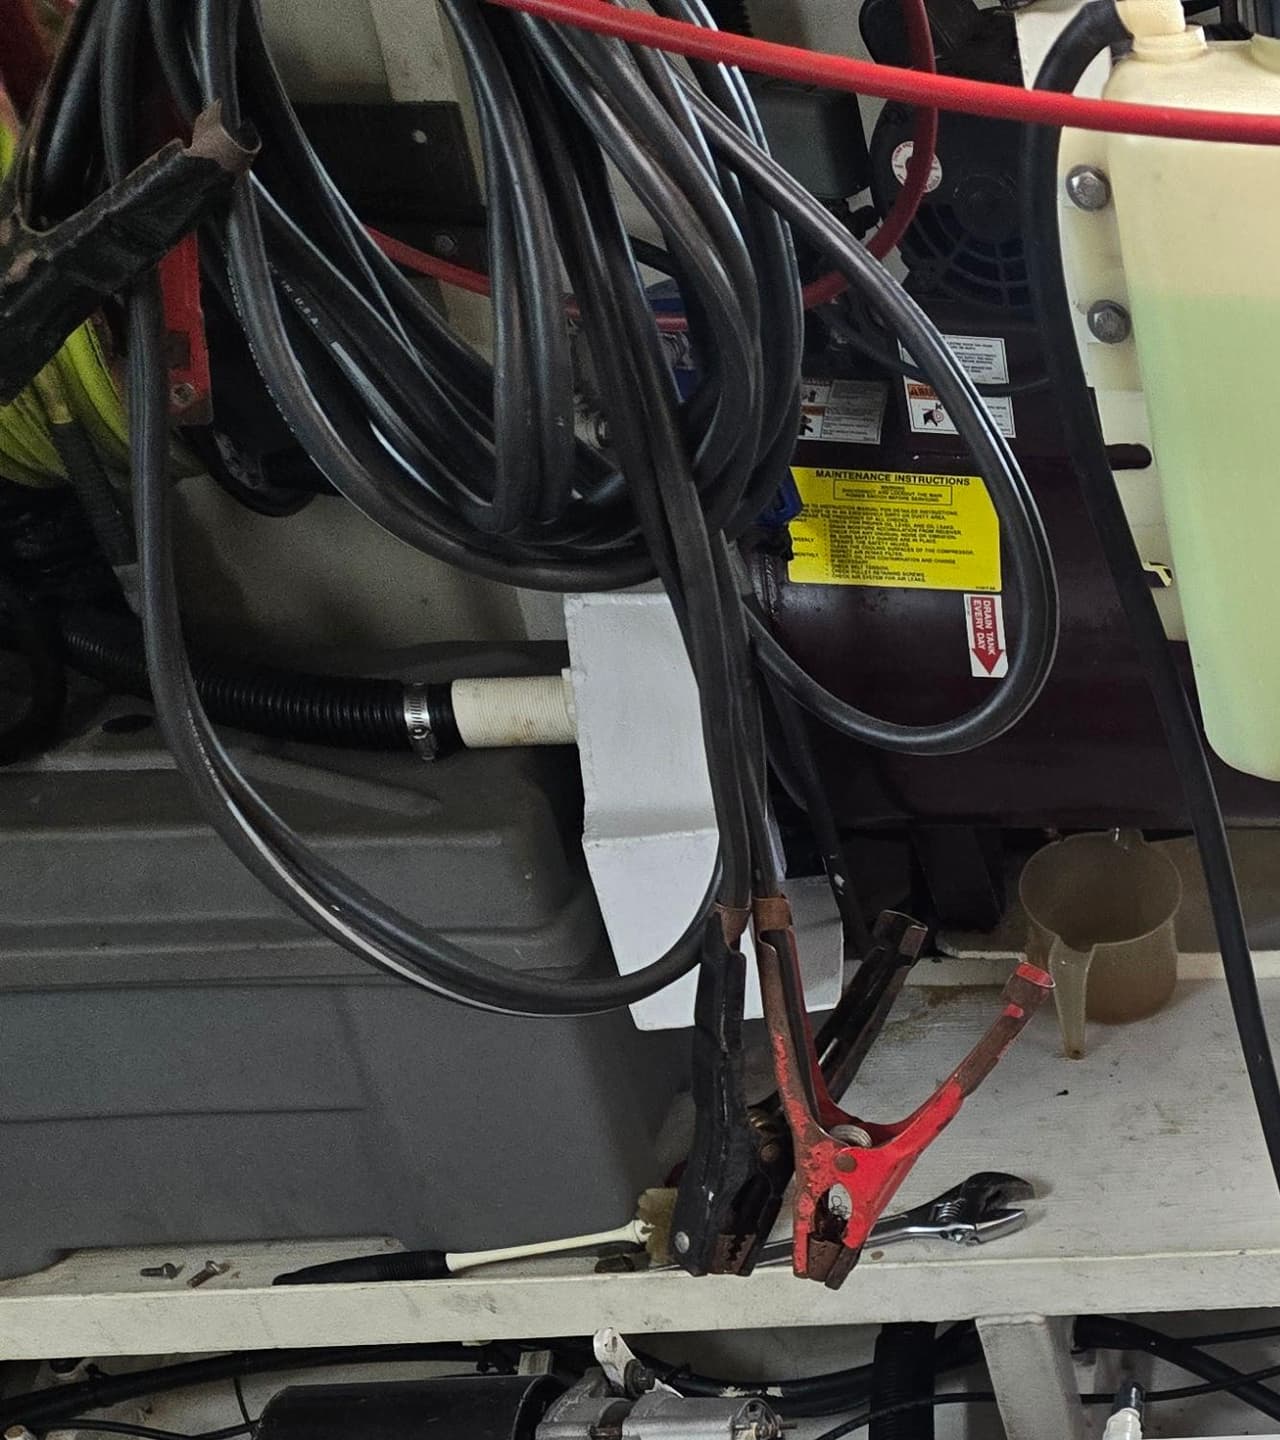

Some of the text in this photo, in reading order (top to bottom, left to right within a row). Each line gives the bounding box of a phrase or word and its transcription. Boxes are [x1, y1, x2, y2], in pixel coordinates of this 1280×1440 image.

[816, 470, 970, 486] MAINTENANCE INSTRUCTIONS
[973, 599, 987, 651] EVERY DAY
[983, 600, 993, 629] DRAIN
[986, 631, 996, 656] TANK
